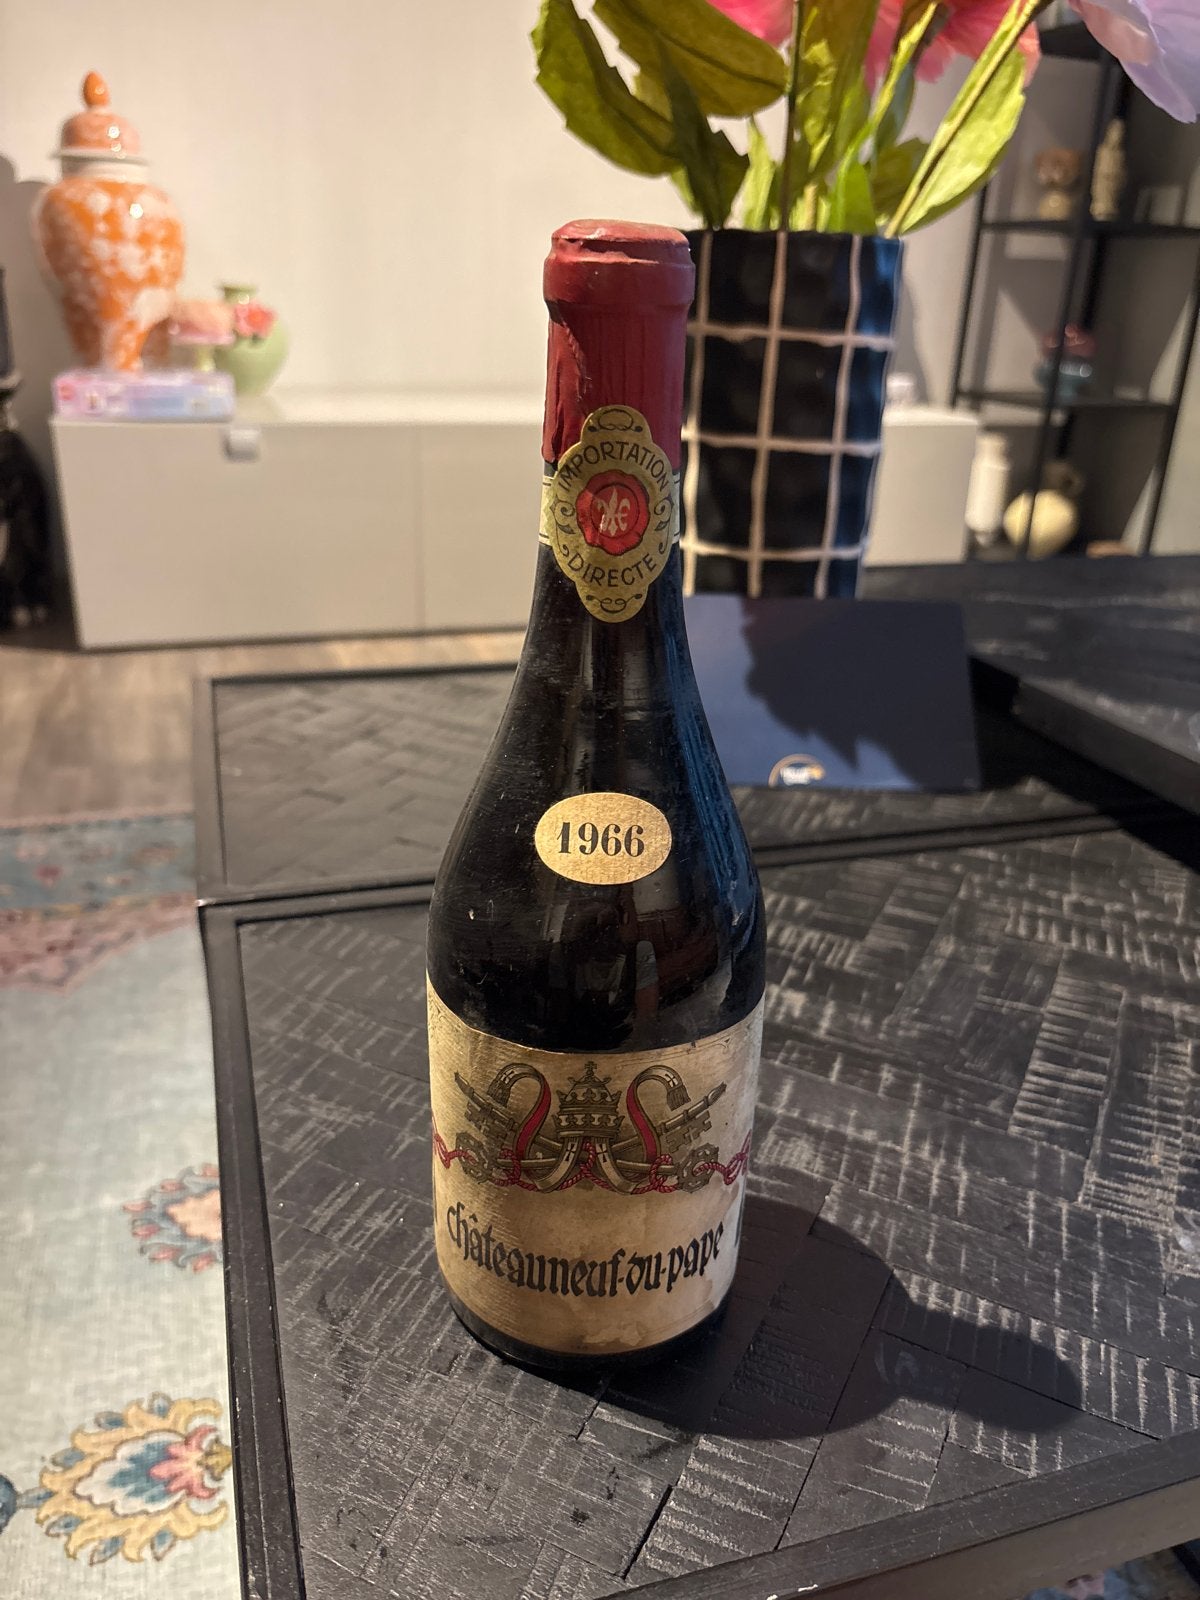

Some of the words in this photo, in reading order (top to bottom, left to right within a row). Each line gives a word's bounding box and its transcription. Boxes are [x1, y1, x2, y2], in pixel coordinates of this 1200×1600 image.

[558, 441, 670, 492] IMPORTATION
[568, 553, 657, 587] DIRECTE
[556, 822, 645, 857] 1966
